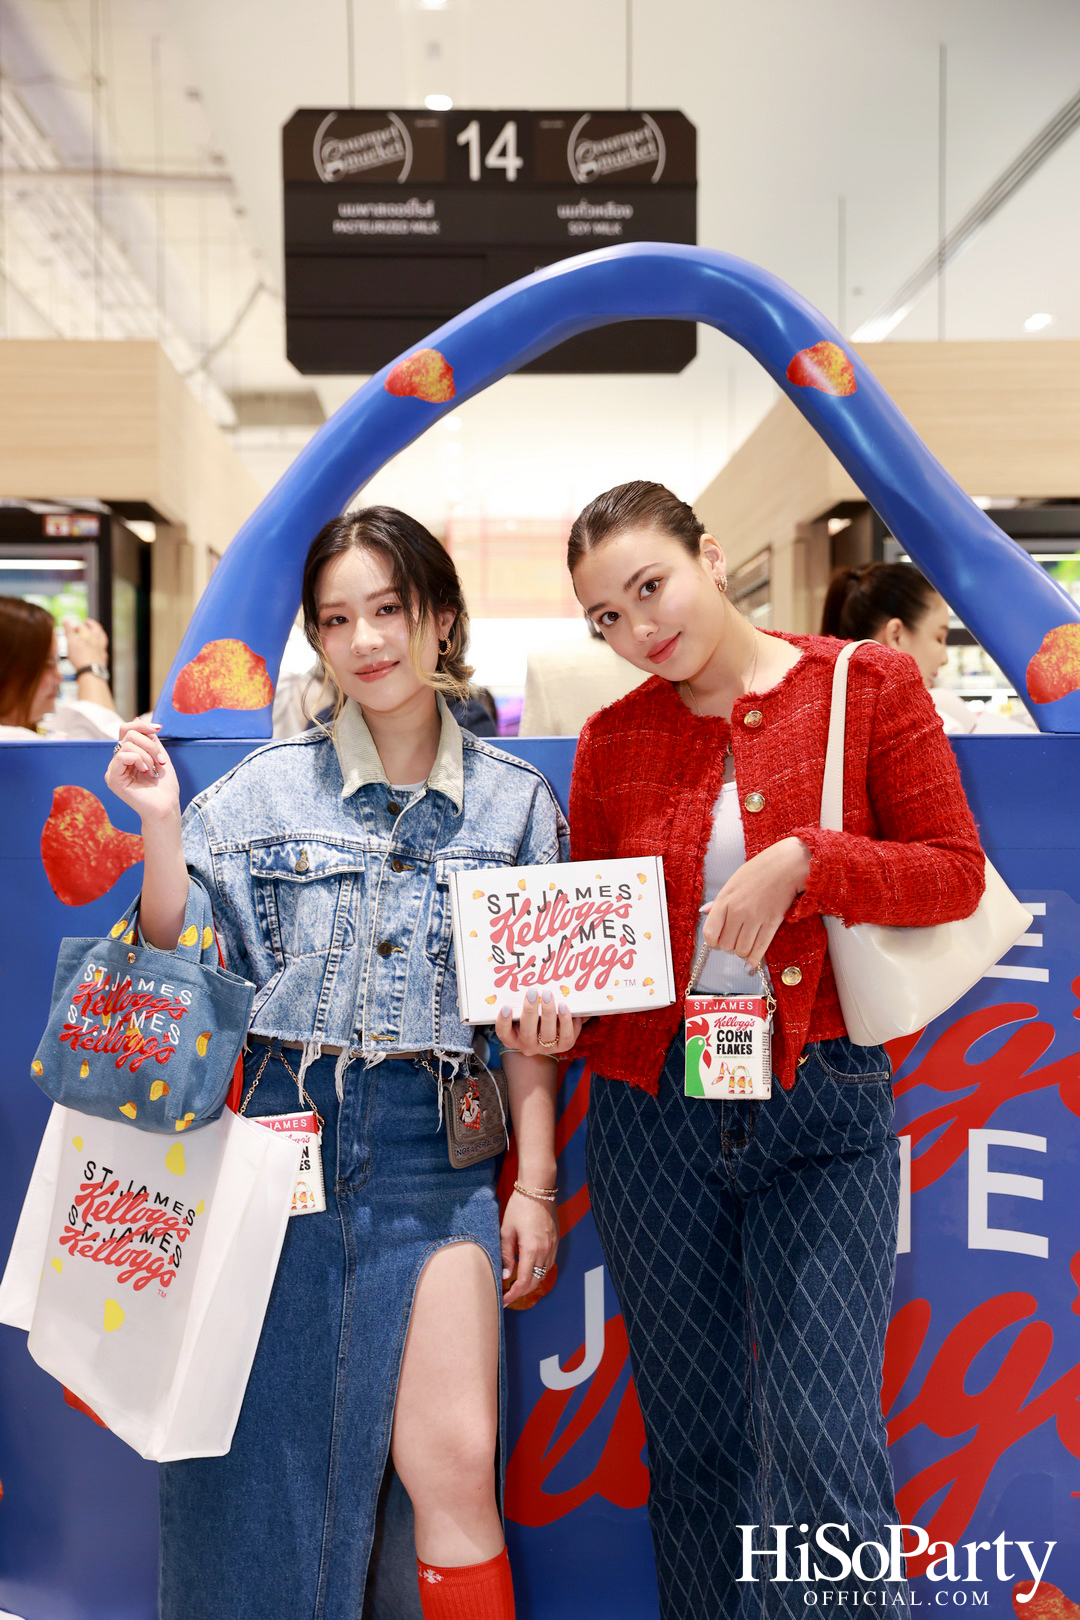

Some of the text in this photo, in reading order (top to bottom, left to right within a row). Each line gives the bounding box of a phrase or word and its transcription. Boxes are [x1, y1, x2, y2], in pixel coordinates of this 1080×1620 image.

[456, 119, 524, 182] 14
[410, 220, 441, 235] MILK
[568, 221, 623, 236] SOY MILK
[490, 893, 633, 954] Kellogg's
[493, 936, 638, 992] Kellogg's
[72, 974, 189, 1020] Kellogg's
[59, 1021, 176, 1073] Kellogg's
[713, 1015, 756, 1031] Kellogg's
[716, 1029, 753, 1042] CORN
[716, 1043, 753, 1055] FLAKES
[74, 1179, 191, 1243] Kellogg's
[59, 1225, 176, 1291] Kellogg's
